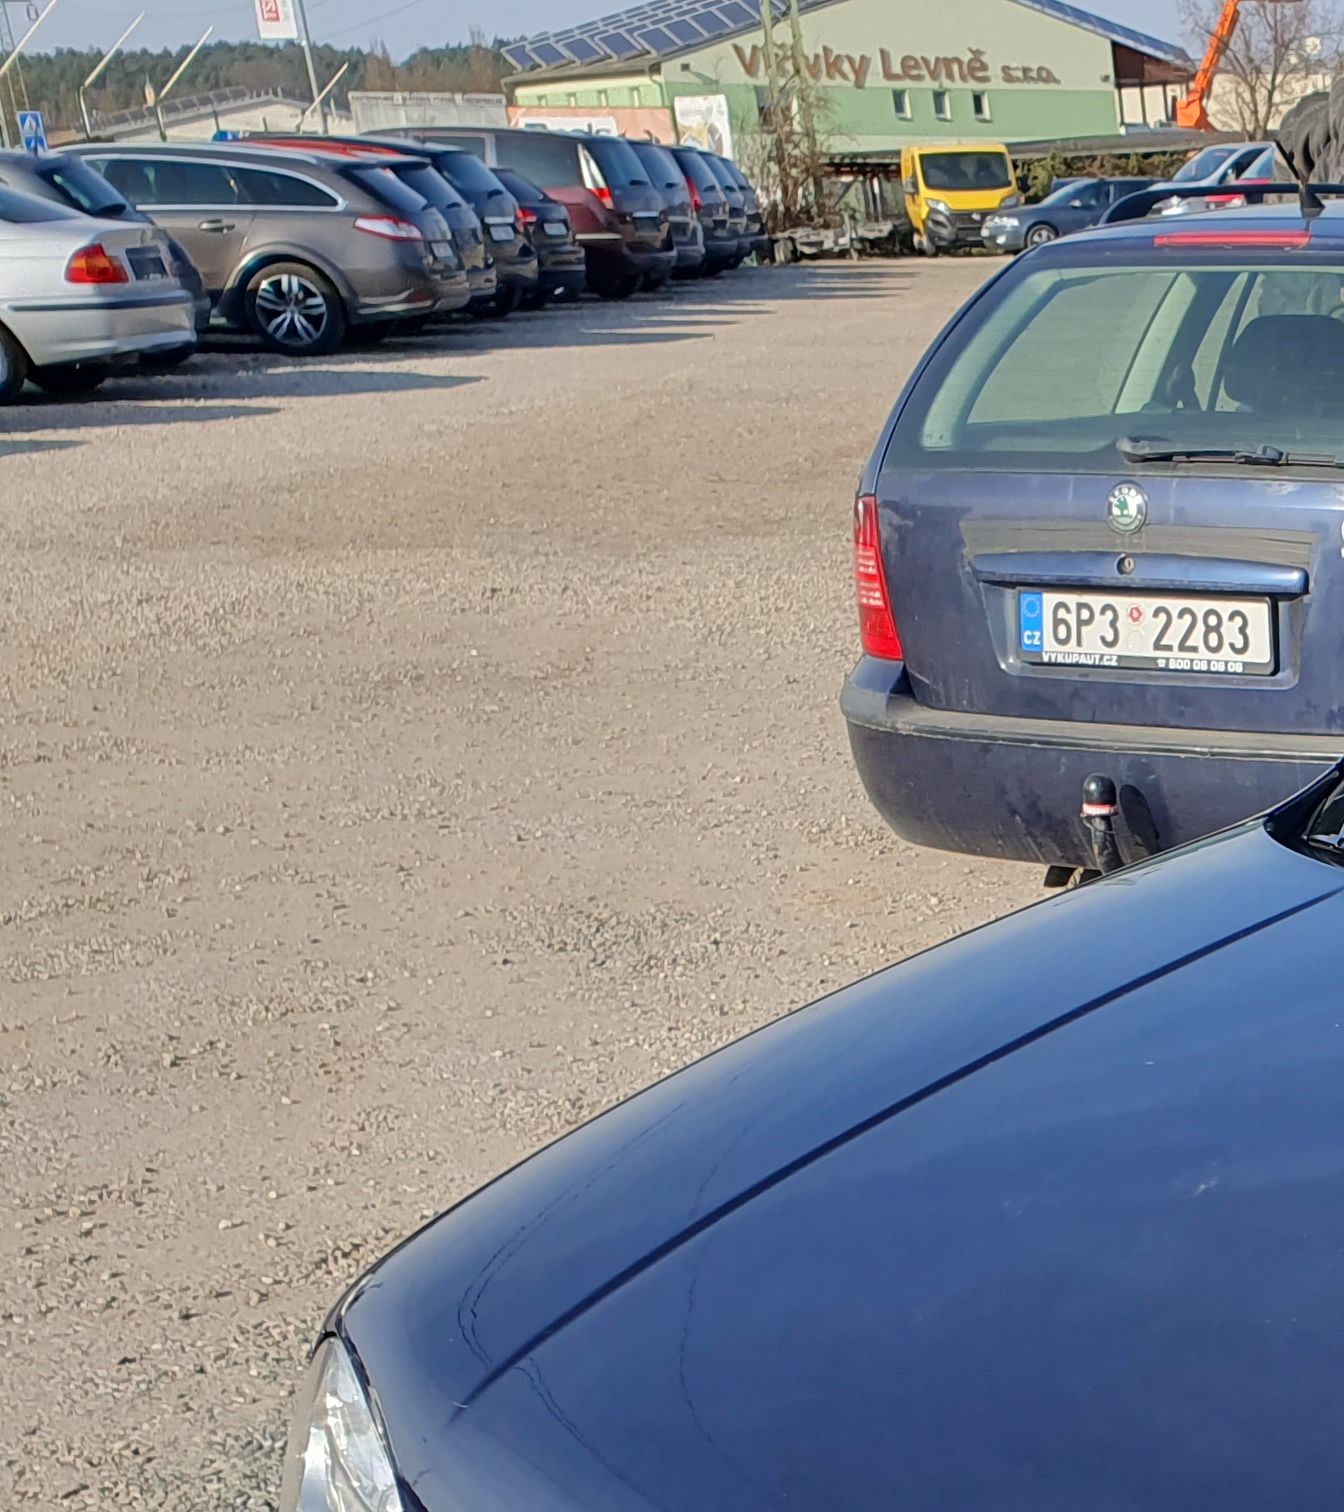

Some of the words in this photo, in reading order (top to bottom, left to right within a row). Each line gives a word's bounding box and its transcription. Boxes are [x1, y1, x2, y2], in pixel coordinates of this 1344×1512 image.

[878, 47, 991, 83] Levně
[1024, 631, 1041, 645] CZ
[1051, 601, 1120, 649] 6P3
[1152, 606, 1250, 655] 2283
